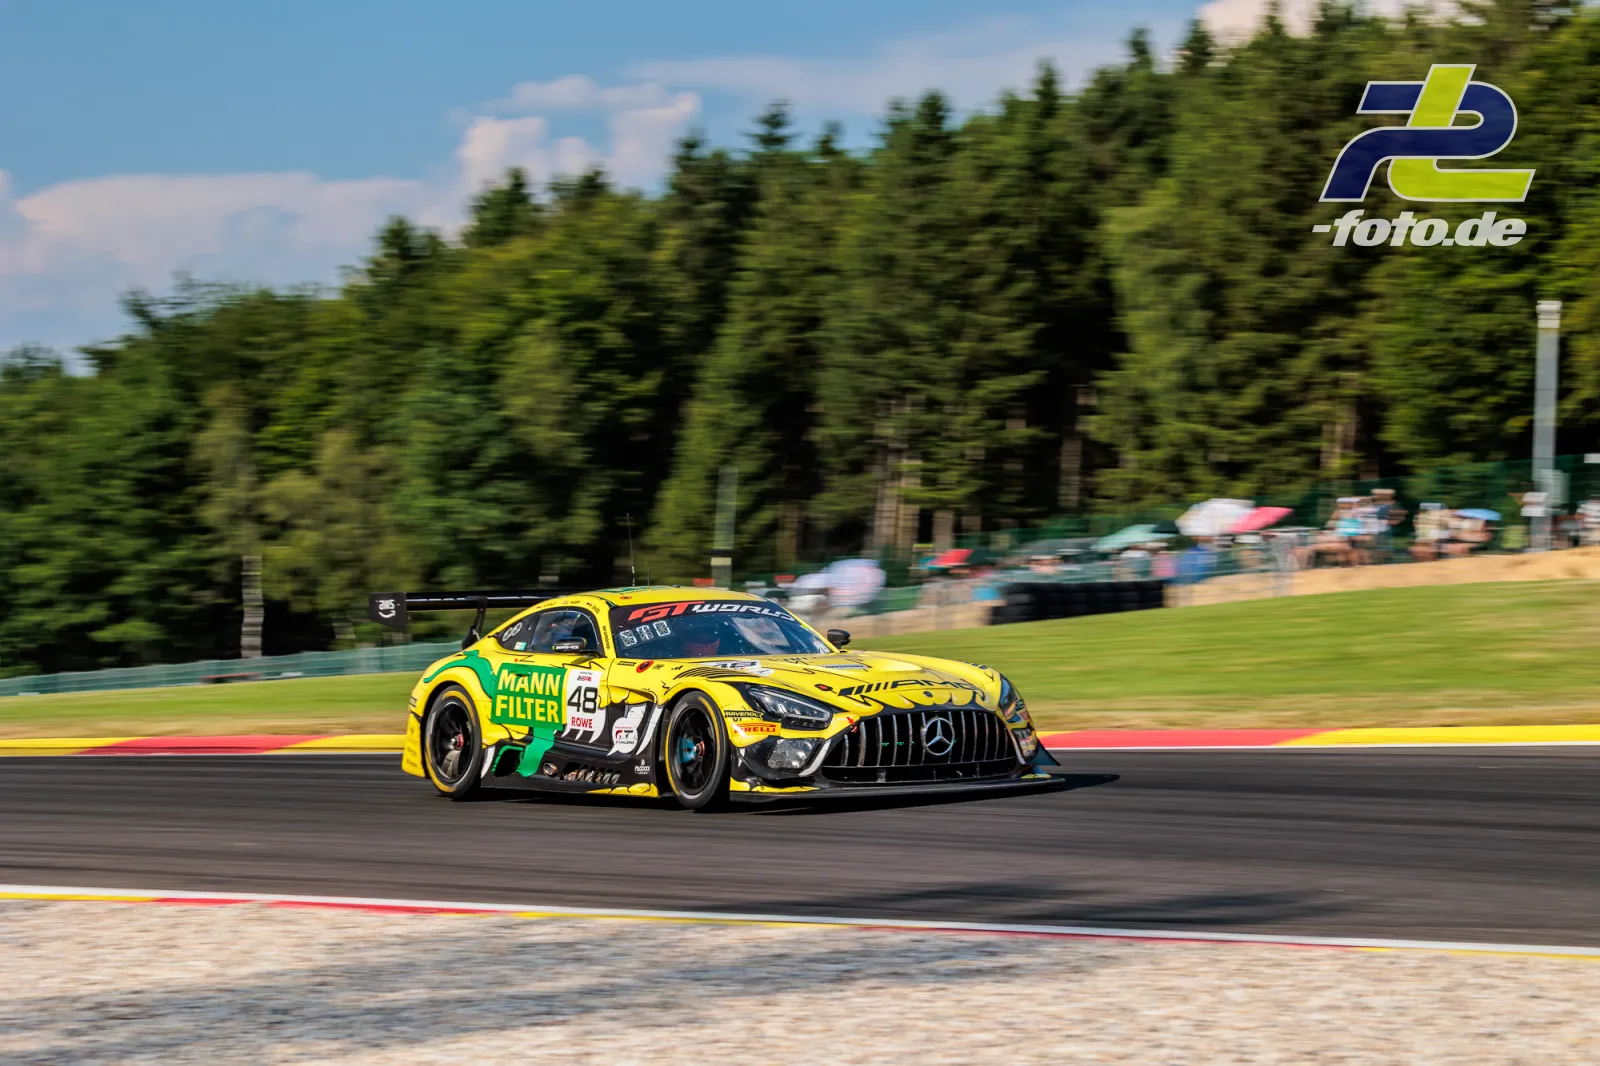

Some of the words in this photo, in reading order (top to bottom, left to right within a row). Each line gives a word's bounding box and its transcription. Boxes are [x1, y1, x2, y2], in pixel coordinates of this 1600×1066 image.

[628, 601, 705, 622] GT
[691, 603, 796, 622] WORLD
[498, 669, 561, 697] MANN
[495, 695, 560, 723] FILTER
[567, 685, 599, 715] 48
[571, 716, 593, 729] ROWE
